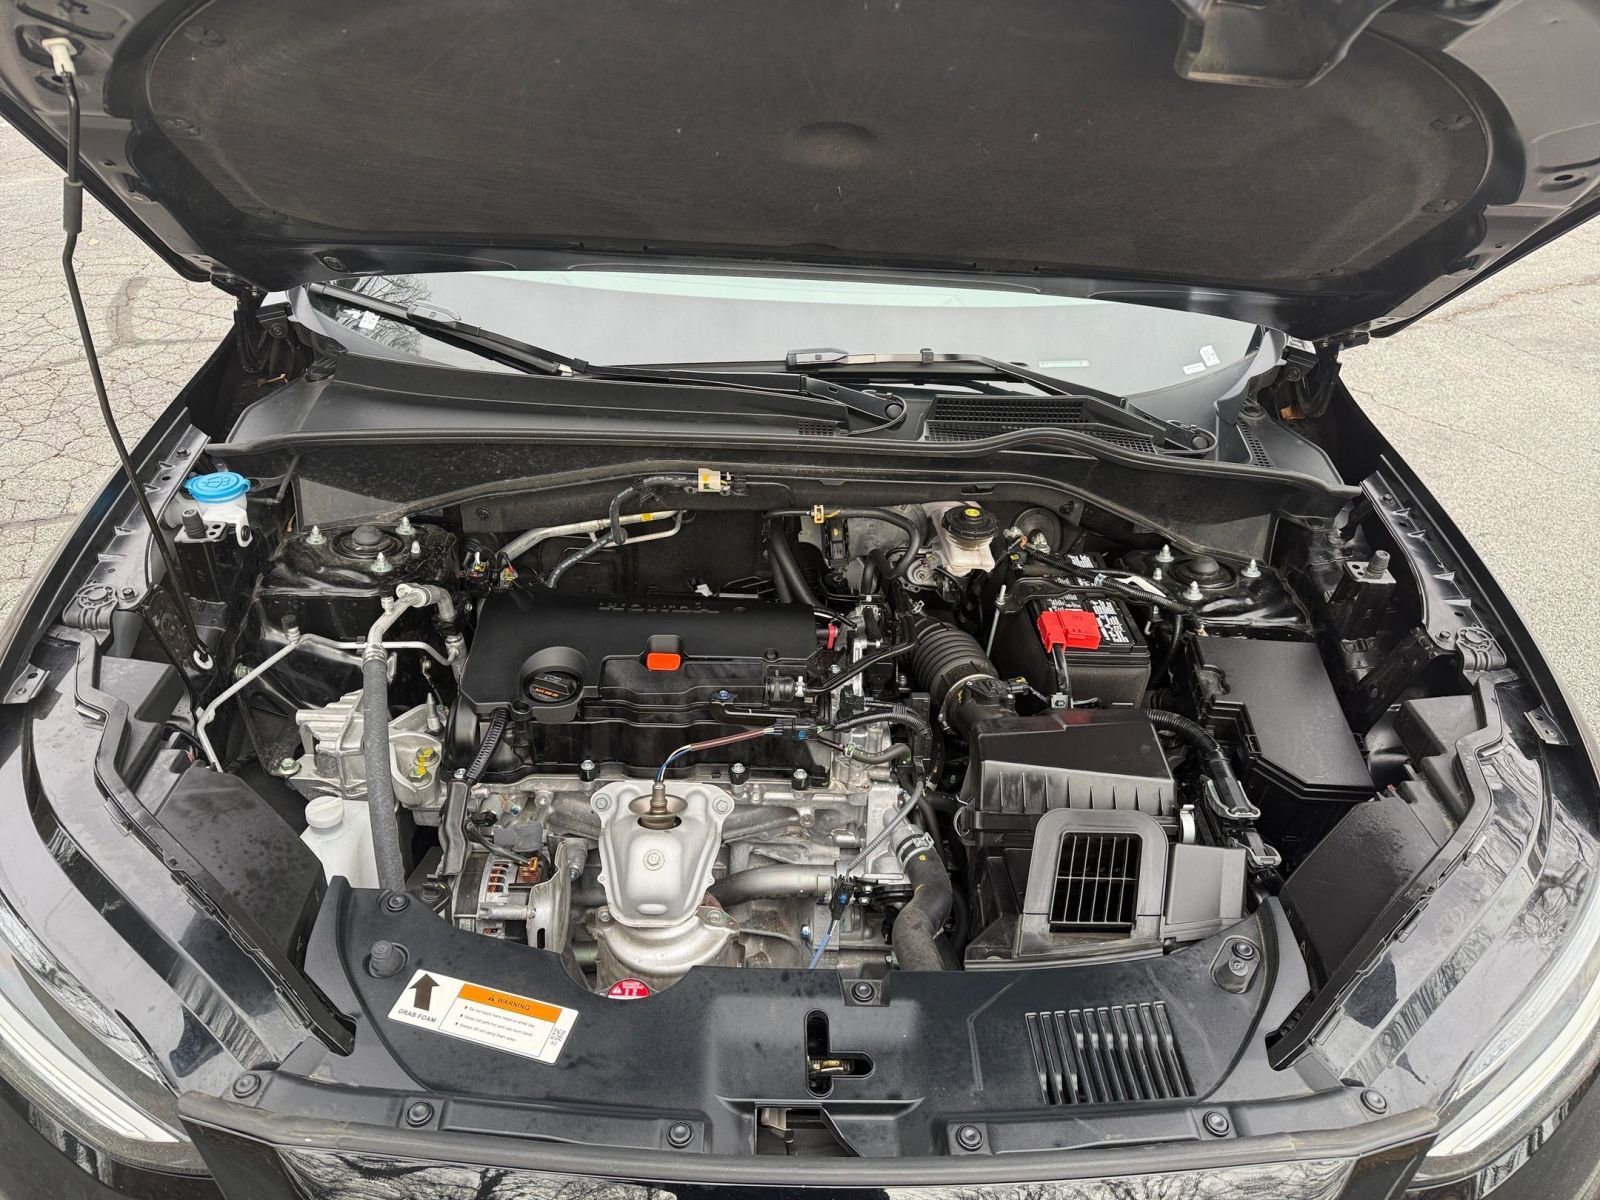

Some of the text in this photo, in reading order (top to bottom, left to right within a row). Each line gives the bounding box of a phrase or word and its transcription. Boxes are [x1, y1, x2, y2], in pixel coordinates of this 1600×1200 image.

[497, 998, 530, 1011] WARNING
[398, 1008, 437, 1023] GRAB FOAM
